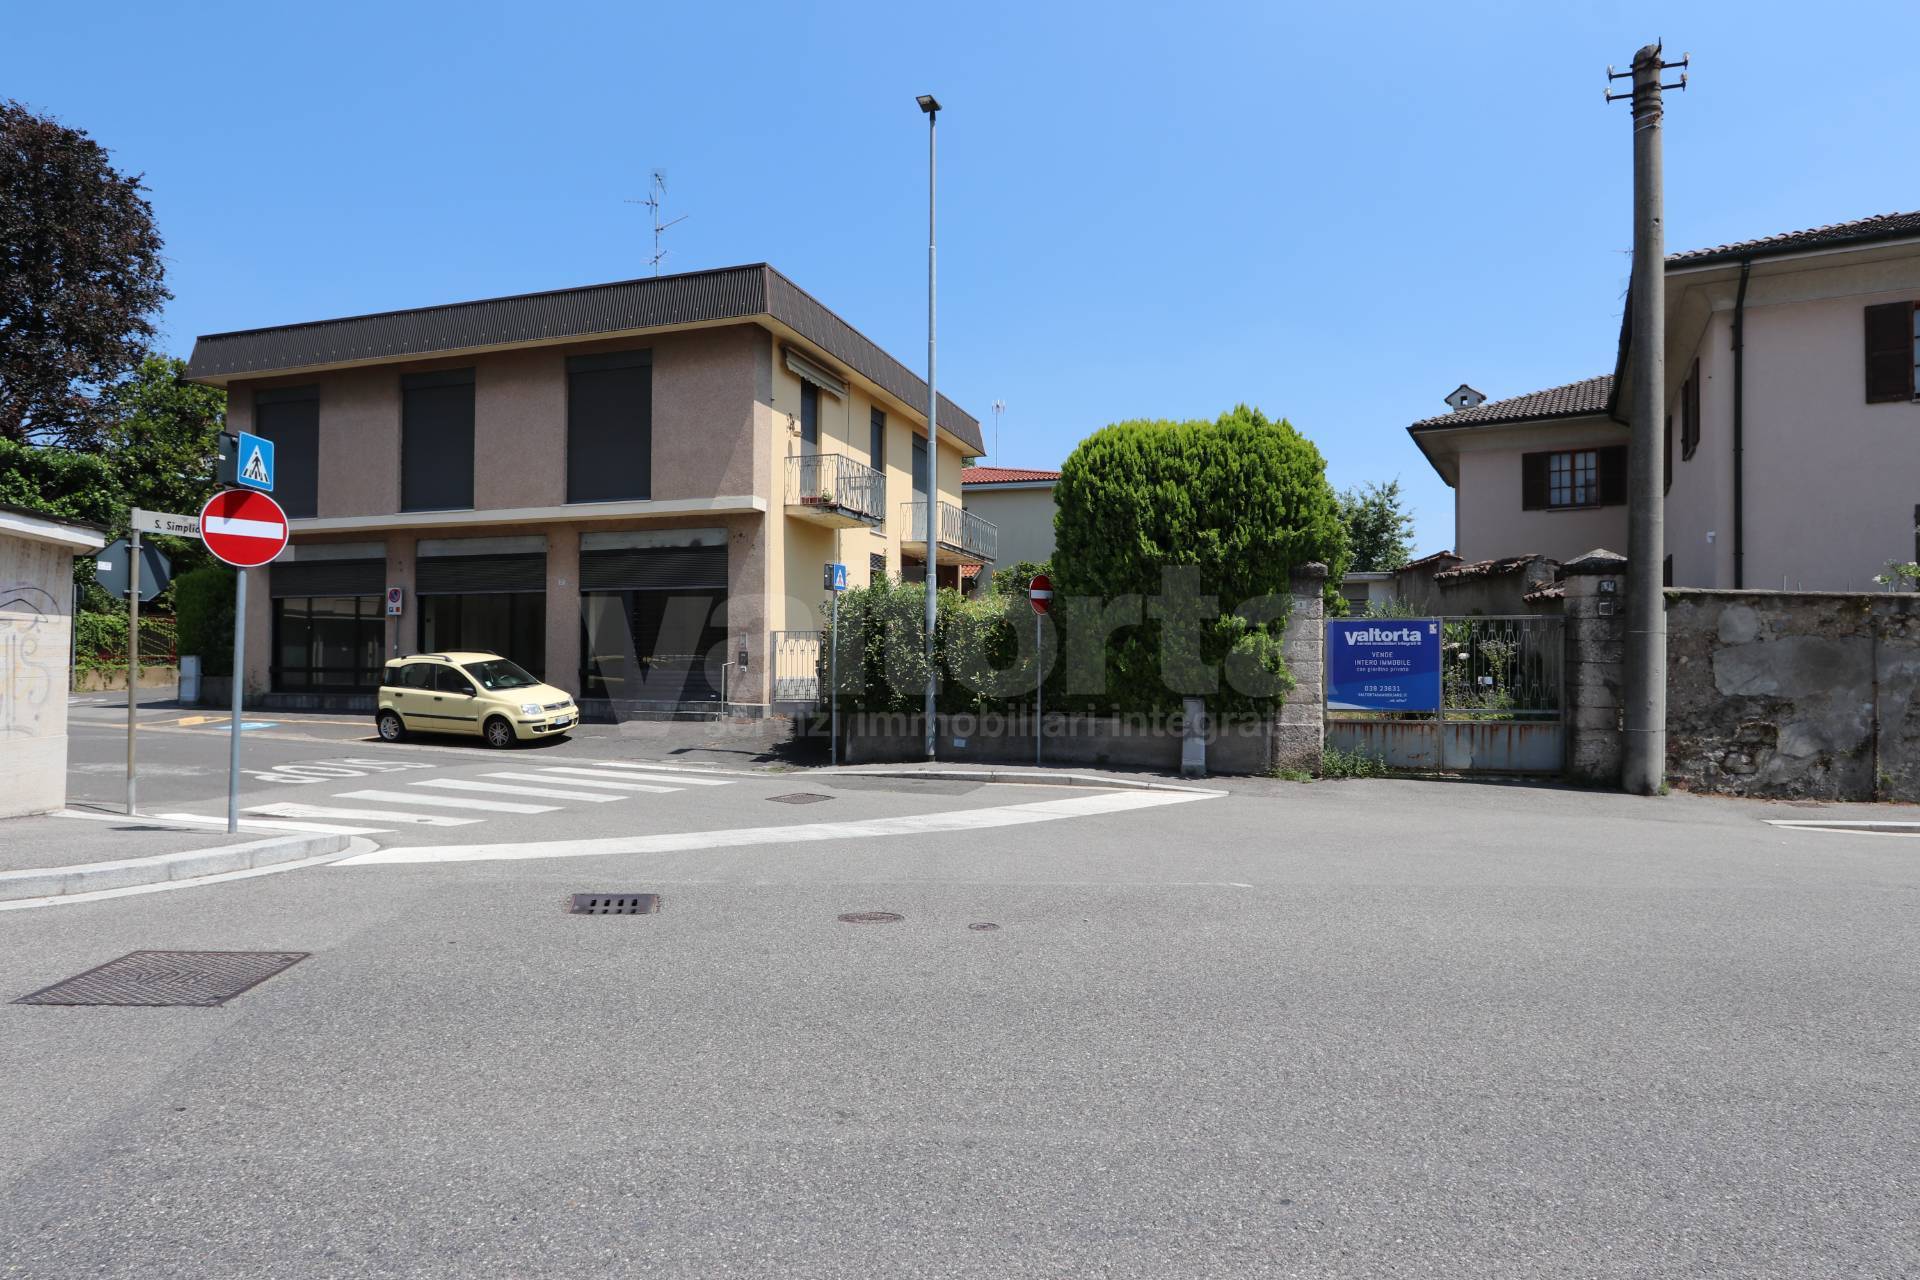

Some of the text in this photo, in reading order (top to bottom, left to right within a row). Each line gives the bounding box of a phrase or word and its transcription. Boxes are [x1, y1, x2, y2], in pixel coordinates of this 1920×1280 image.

[154, 519, 162, 529] S.
[1344, 627, 1422, 646] valtorta
[240, 758, 437, 784] STOP
